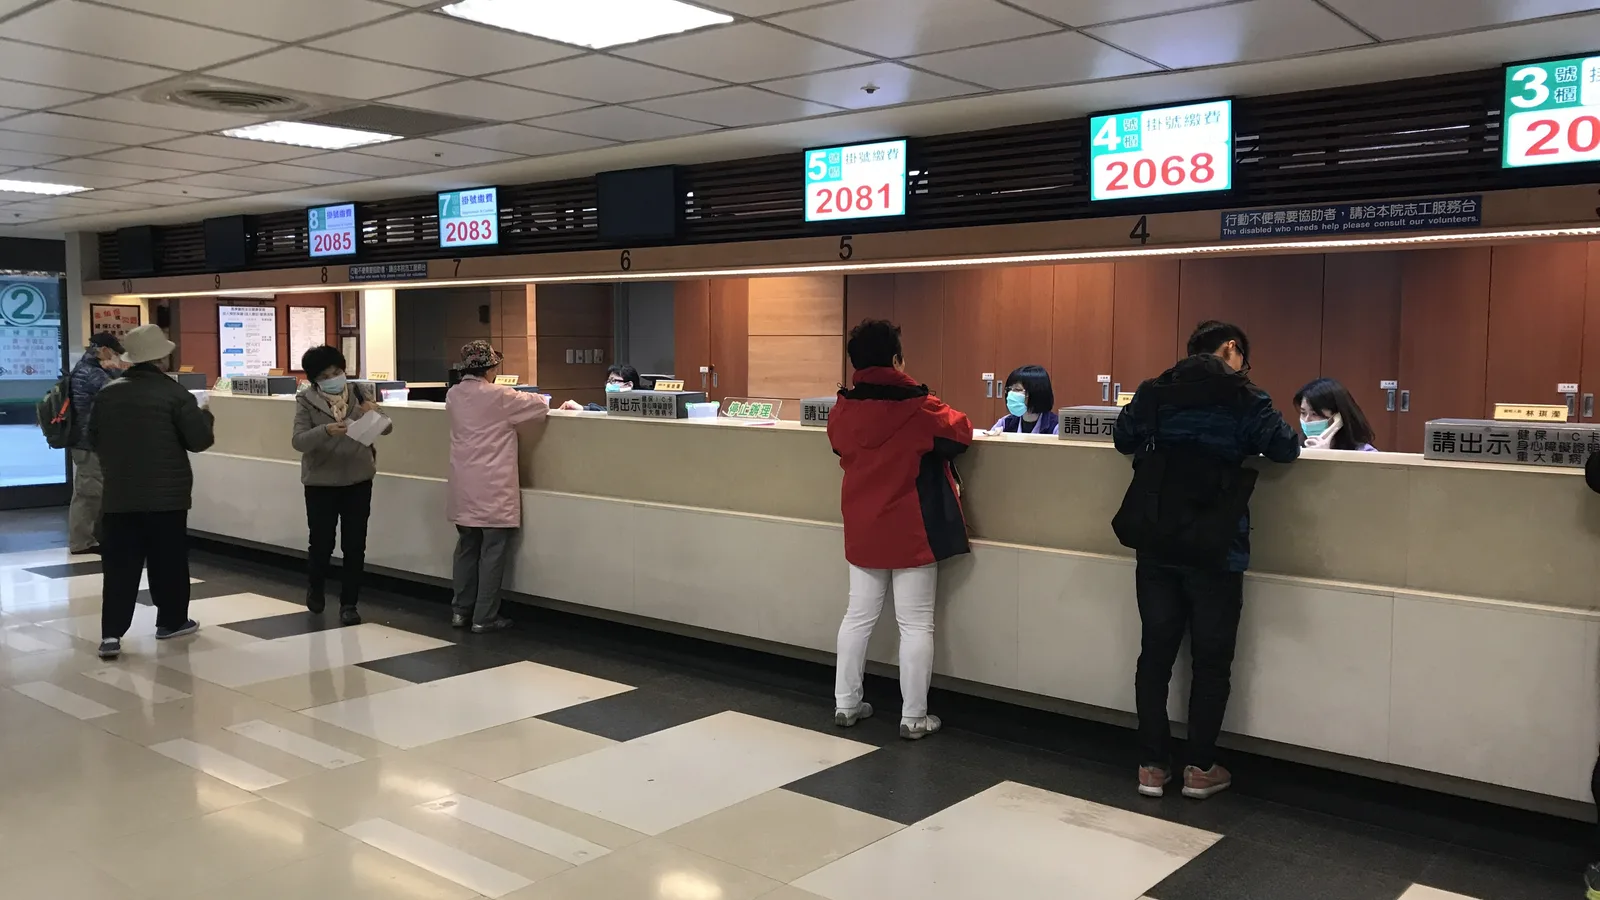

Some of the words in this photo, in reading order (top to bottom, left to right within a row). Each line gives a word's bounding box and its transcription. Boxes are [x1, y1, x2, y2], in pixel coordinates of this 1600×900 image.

[1510, 66, 1550, 108] 3
[1147, 110, 1221, 131] 掛號繳費
[1093, 116, 1121, 151] 4
[808, 151, 827, 181] 5
[1105, 152, 1215, 191] 2068
[440, 194, 451, 217] 7
[816, 183, 890, 214] 2081
[309, 209, 319, 230] 8
[446, 219, 492, 242] 2083
[1129, 215, 1150, 245] 4
[1240, 226, 1272, 234] disabled
[1294, 223, 1318, 232] needs
[1321, 222, 1339, 231] help
[1342, 220, 1370, 230] please
[1374, 218, 1405, 227] consult
[1428, 215, 1479, 224] volunteers.
[314, 232, 352, 253] 2085
[839, 235, 853, 260] 5
[453, 259, 462, 277] 7
[620, 249, 631, 271] 6
[214, 274, 221, 290] 9
[321, 266, 328, 283] 8
[122, 279, 133, 293] 10
[11, 289, 35, 319] 2
[609, 397, 640, 412] 請出示
[1064, 416, 1116, 436] 請出示
[1432, 431, 1512, 455] 請出示
